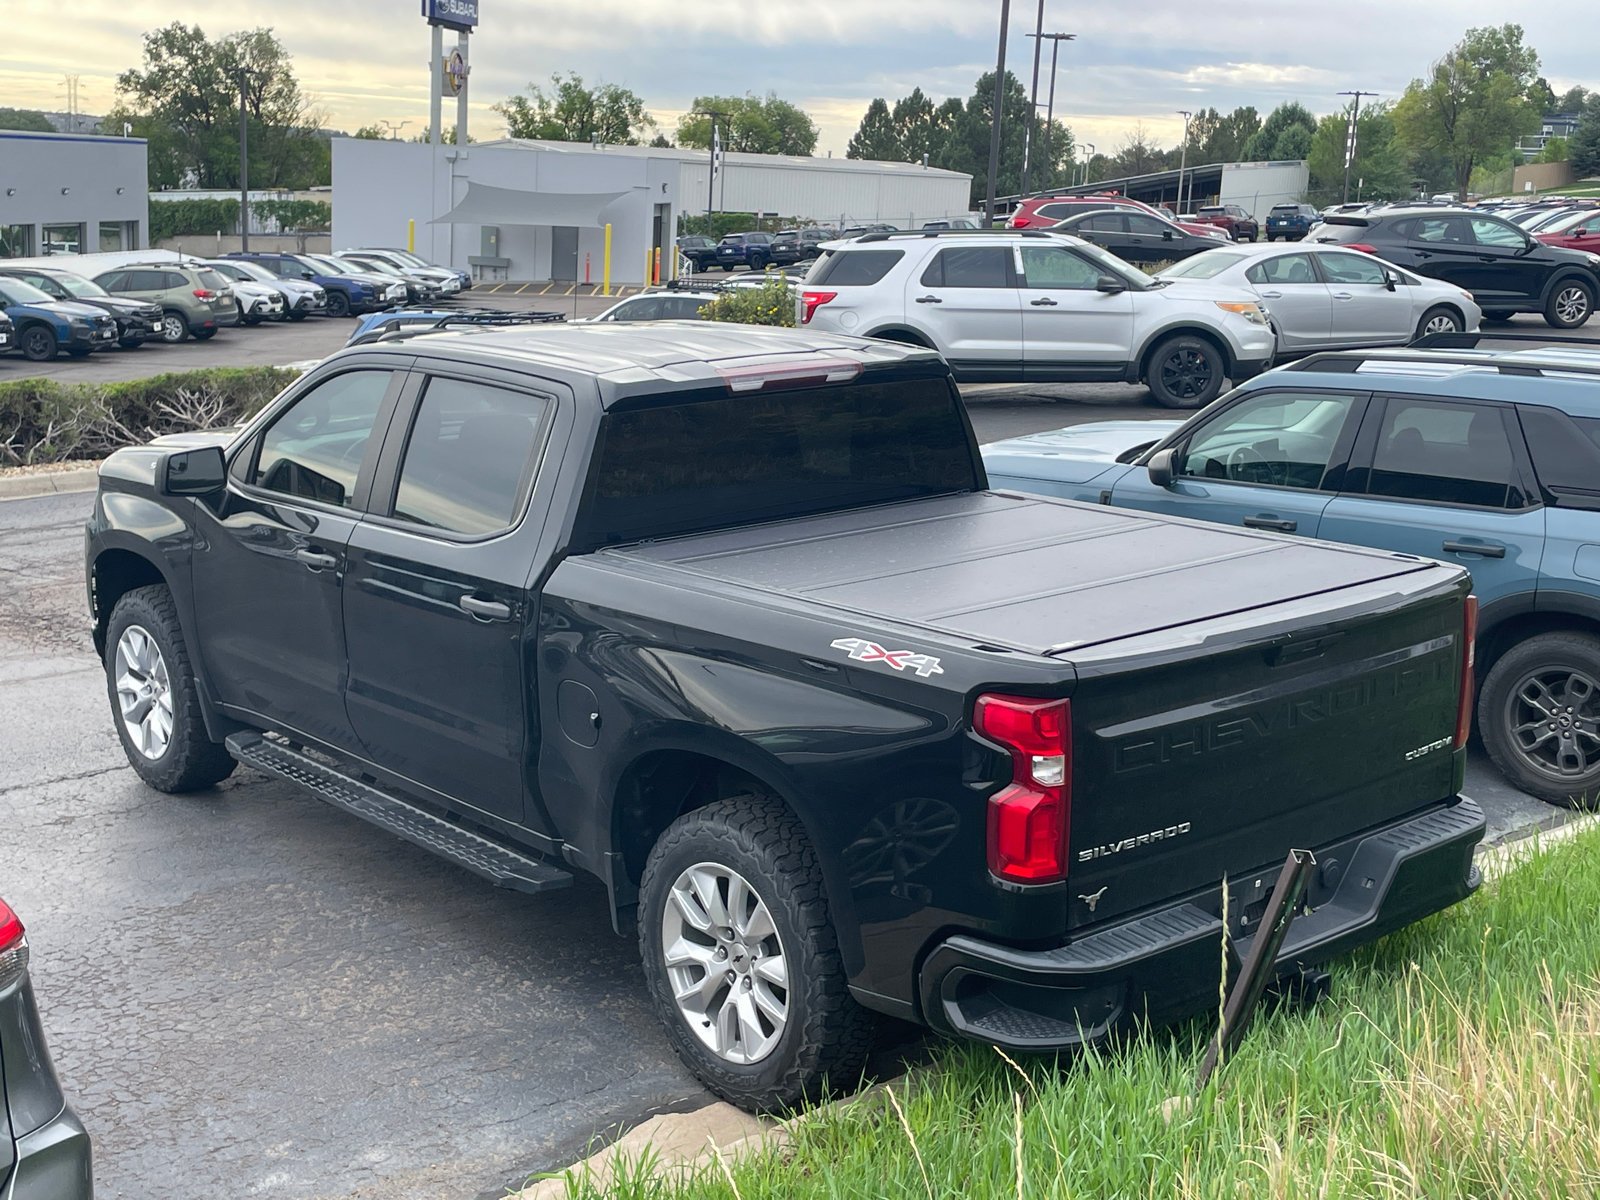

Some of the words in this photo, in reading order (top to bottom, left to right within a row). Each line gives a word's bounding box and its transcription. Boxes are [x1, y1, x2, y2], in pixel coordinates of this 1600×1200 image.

[450, 0, 478, 18] SUBARU
[1405, 735, 1453, 761] CUSTOM
[1078, 821, 1191, 862] SILVERADO
